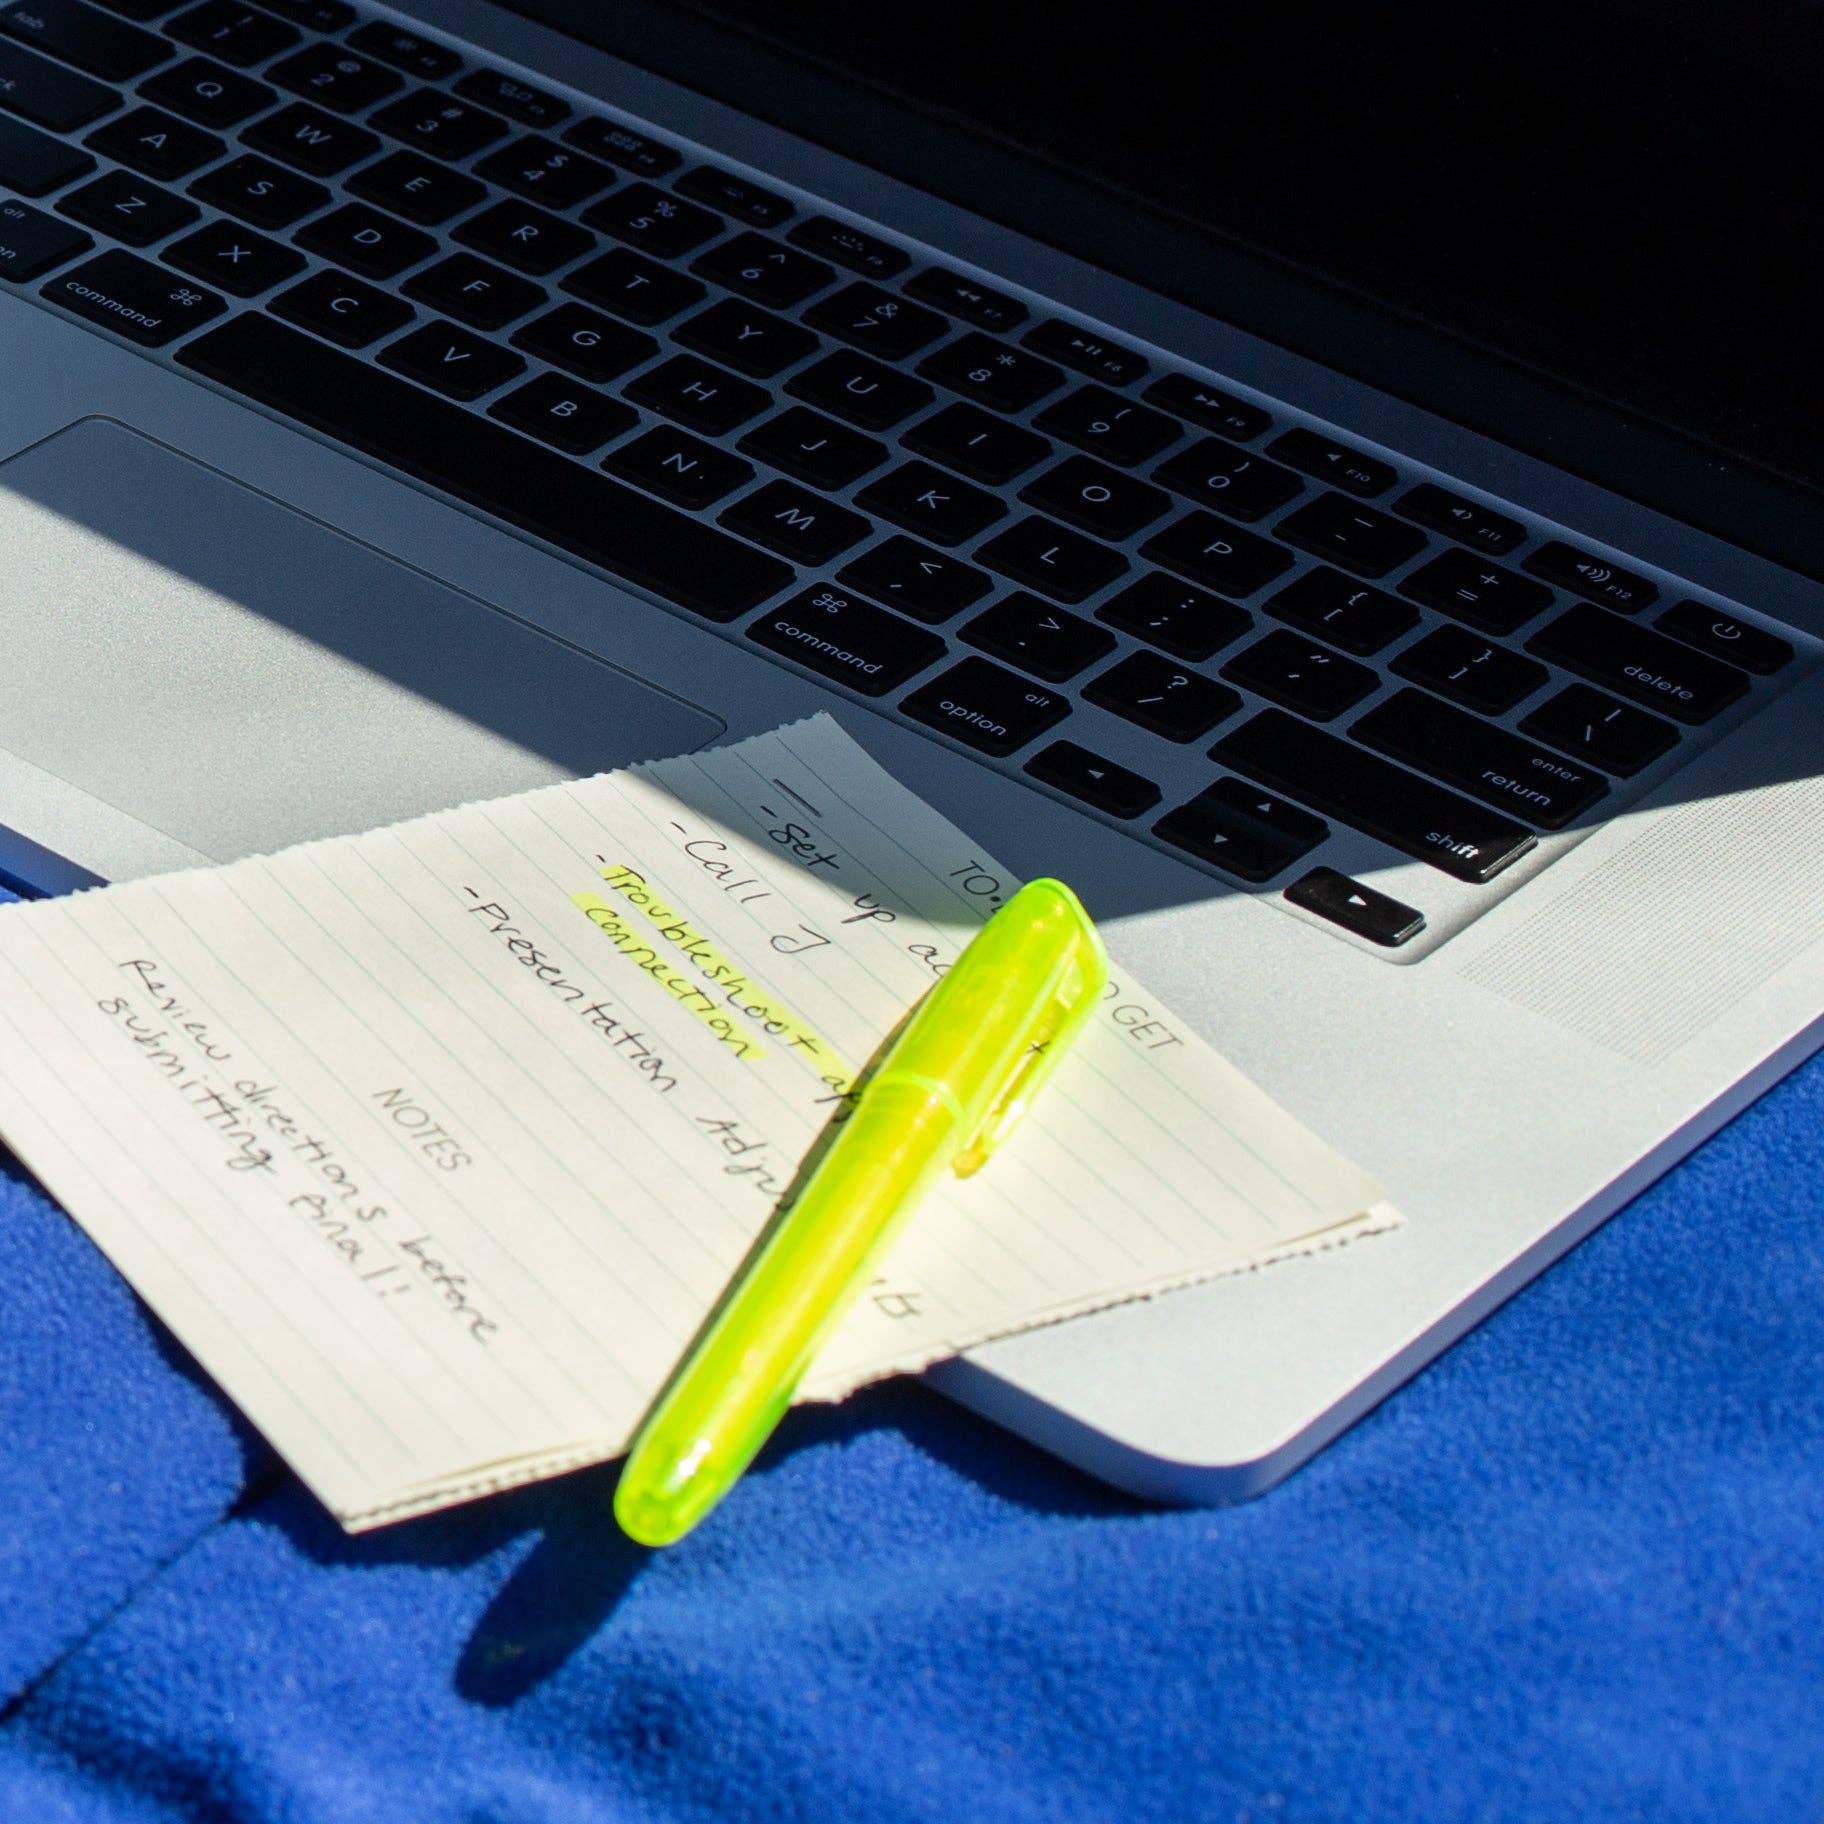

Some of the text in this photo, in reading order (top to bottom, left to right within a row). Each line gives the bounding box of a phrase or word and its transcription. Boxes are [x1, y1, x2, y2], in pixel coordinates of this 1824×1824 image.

[196, 82, 223, 98] Q
[140, 134, 166, 148] A
[296, 125, 331, 144] W
[248, 181, 273, 195] S
[405, 177, 431, 191] E
[2, 205, 28, 222] alt
[115, 197, 146, 213] Z
[353, 229, 381, 243] D
[512, 225, 538, 241] R
[219, 245, 251, 263] X
[463, 280, 490, 291] F
[627, 275, 649, 288] T
[64, 278, 160, 332] command
[331, 298, 358, 313] C
[572, 331, 601, 346] G
[738, 325, 763, 339] Y
[444, 347, 470, 362] V
[969, 369, 992, 381] 8
[683, 382, 717, 401] H
[846, 376, 878, 394] U
[551, 401, 577, 416] B
[801, 440, 827, 450] J
[662, 453, 697, 472] N
[1346, 467, 1371, 483] F10
[917, 490, 950, 509] K
[1082, 486, 1111, 502] O
[775, 508, 815, 530] M
[1478, 526, 1502, 542] F11
[1041, 547, 1059, 564] L
[1204, 541, 1232, 554] P
[1606, 583, 1633, 600] F12
[772, 616, 886, 676] command
[1168, 676, 1188, 689] ?
[1622, 663, 1697, 702] delete
[1023, 692, 1051, 709] alt
[937, 696, 1009, 738] option
[1530, 755, 1583, 784] enter
[1481, 768, 1554, 809] return
[1423, 827, 1484, 862] shift
[841, 893, 897, 925] up
[769, 923, 832, 955] J
[1111, 1003, 1184, 1050] GET
[97, 996, 278, 1176] submitting
[371, 1086, 473, 1173] NOTES
[234, 1078, 389, 1224] directions
[398, 1235, 499, 1346] before
